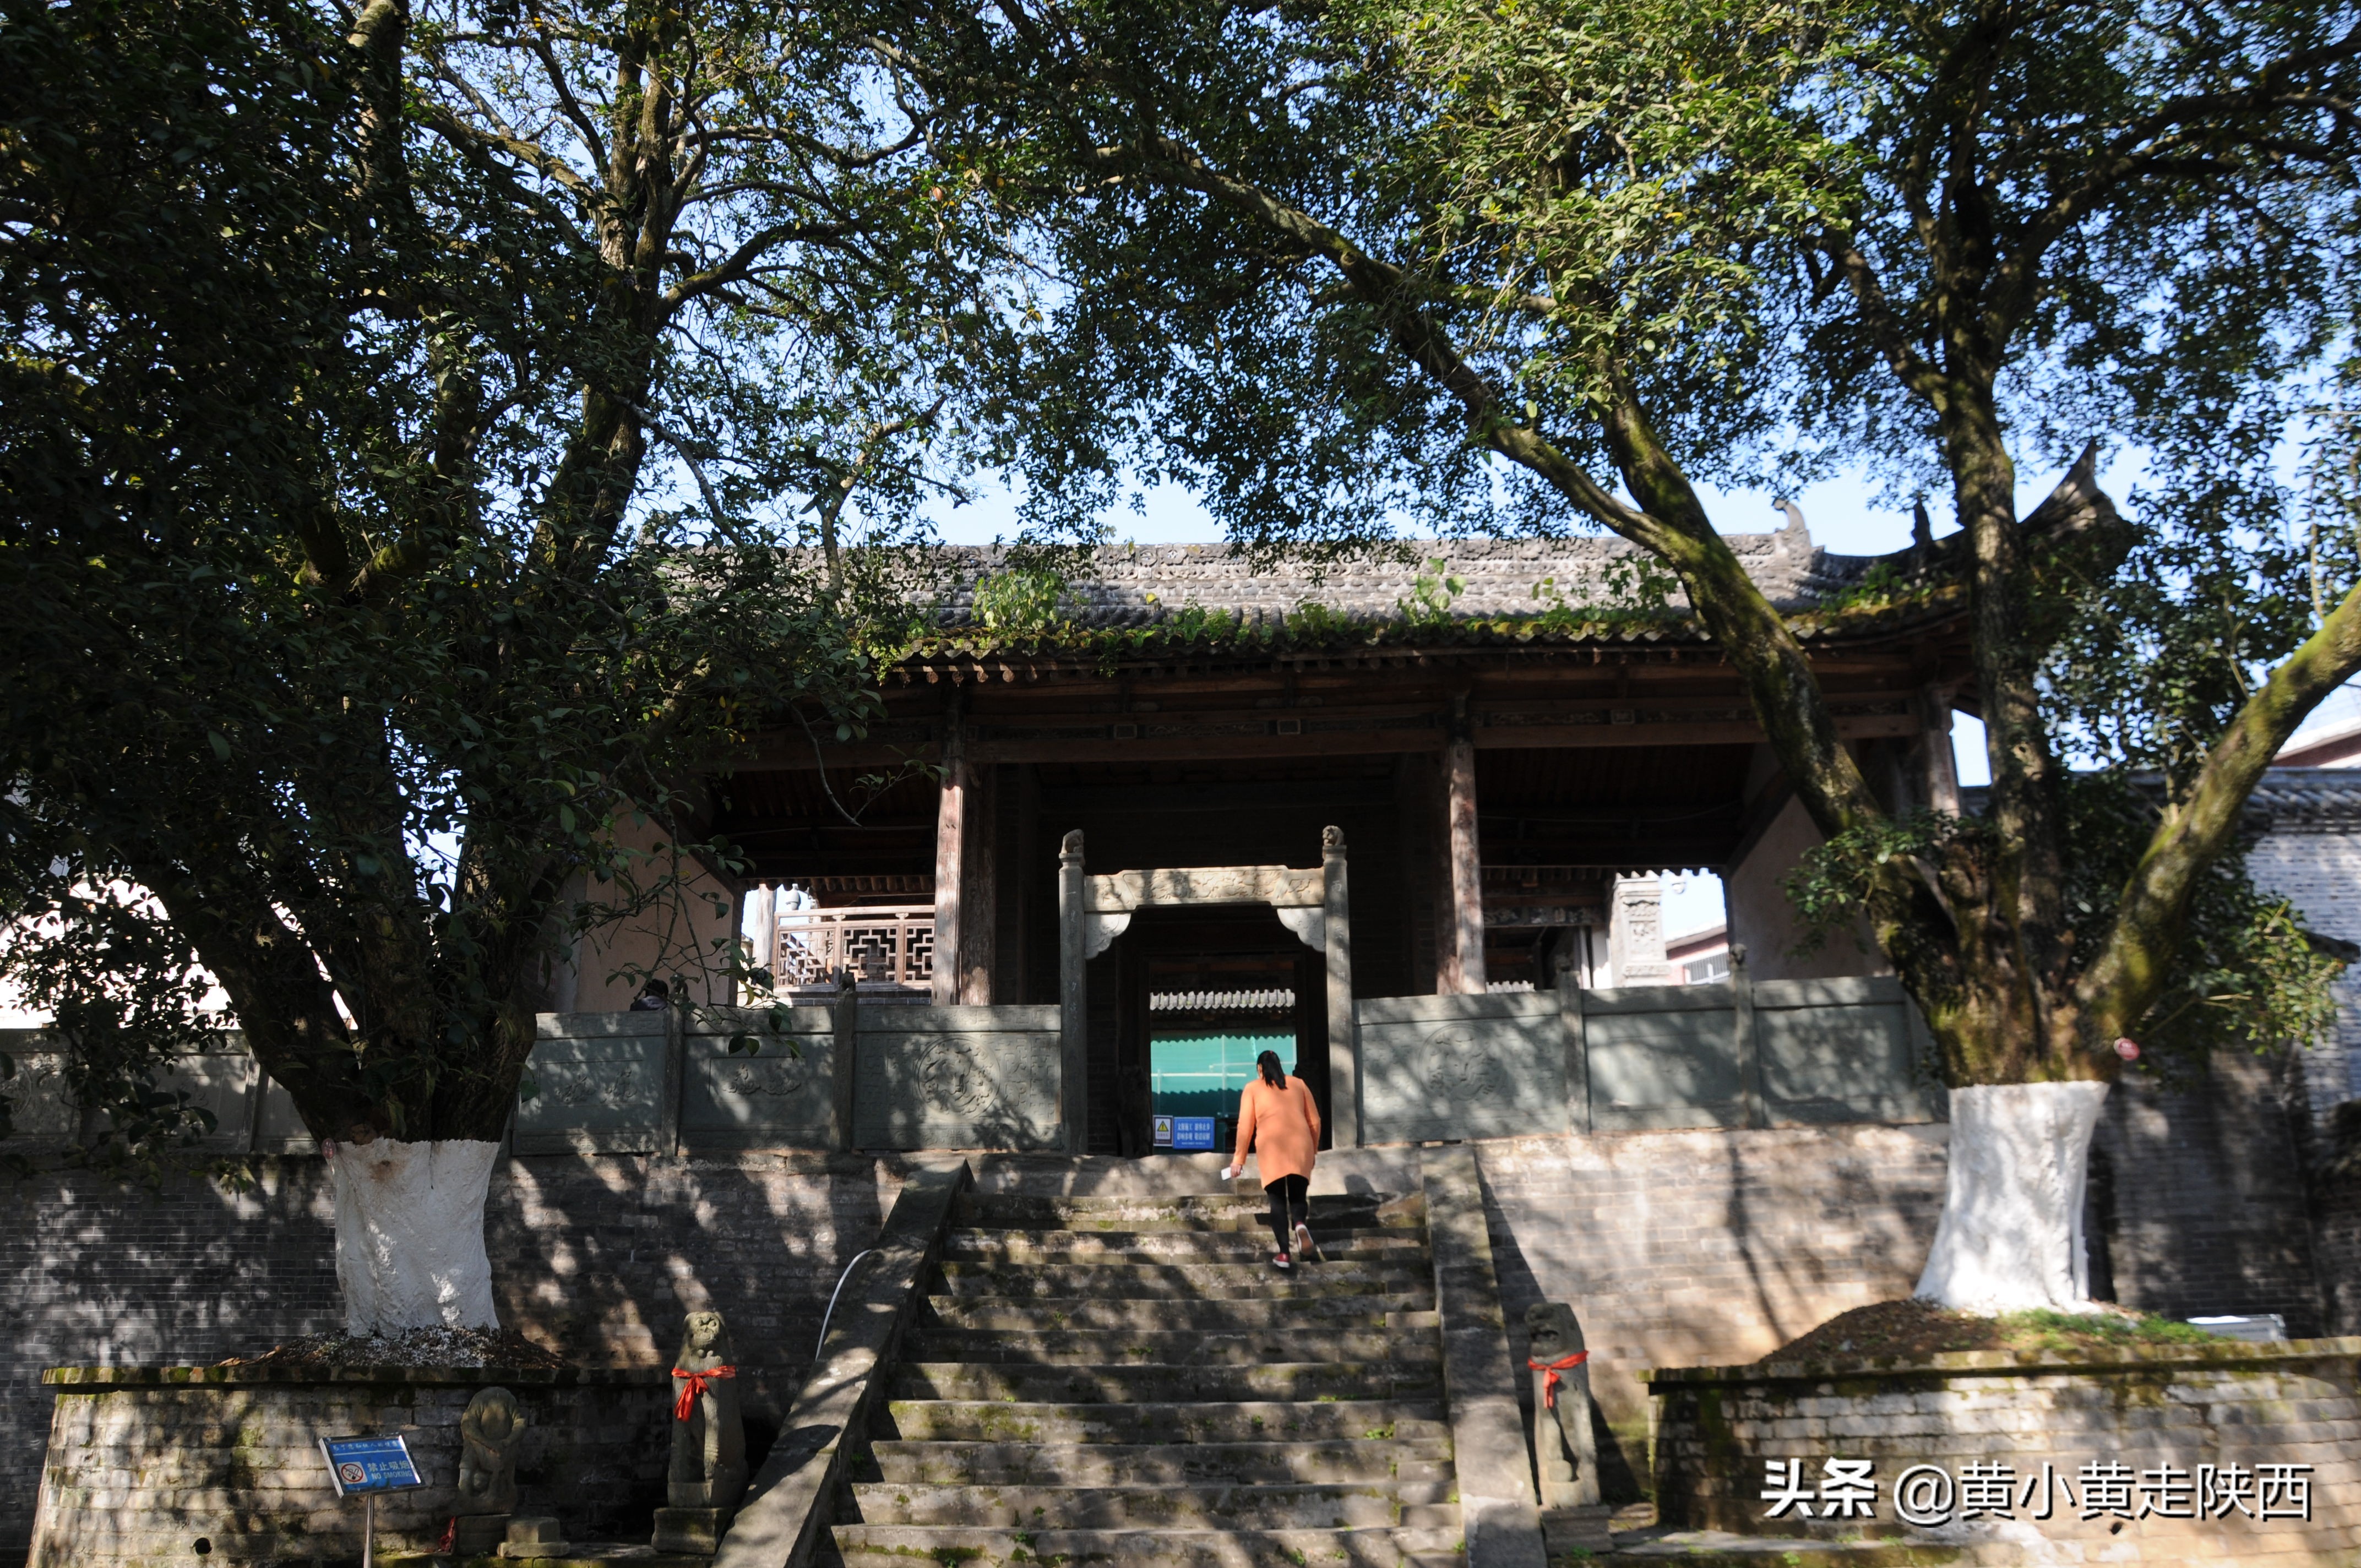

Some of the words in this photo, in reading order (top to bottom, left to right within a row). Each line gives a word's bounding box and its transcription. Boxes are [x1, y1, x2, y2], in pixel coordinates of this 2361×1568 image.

[367, 1460, 410, 1472] 禁止吸烟
[384, 1471, 413, 1479] SMOKING
